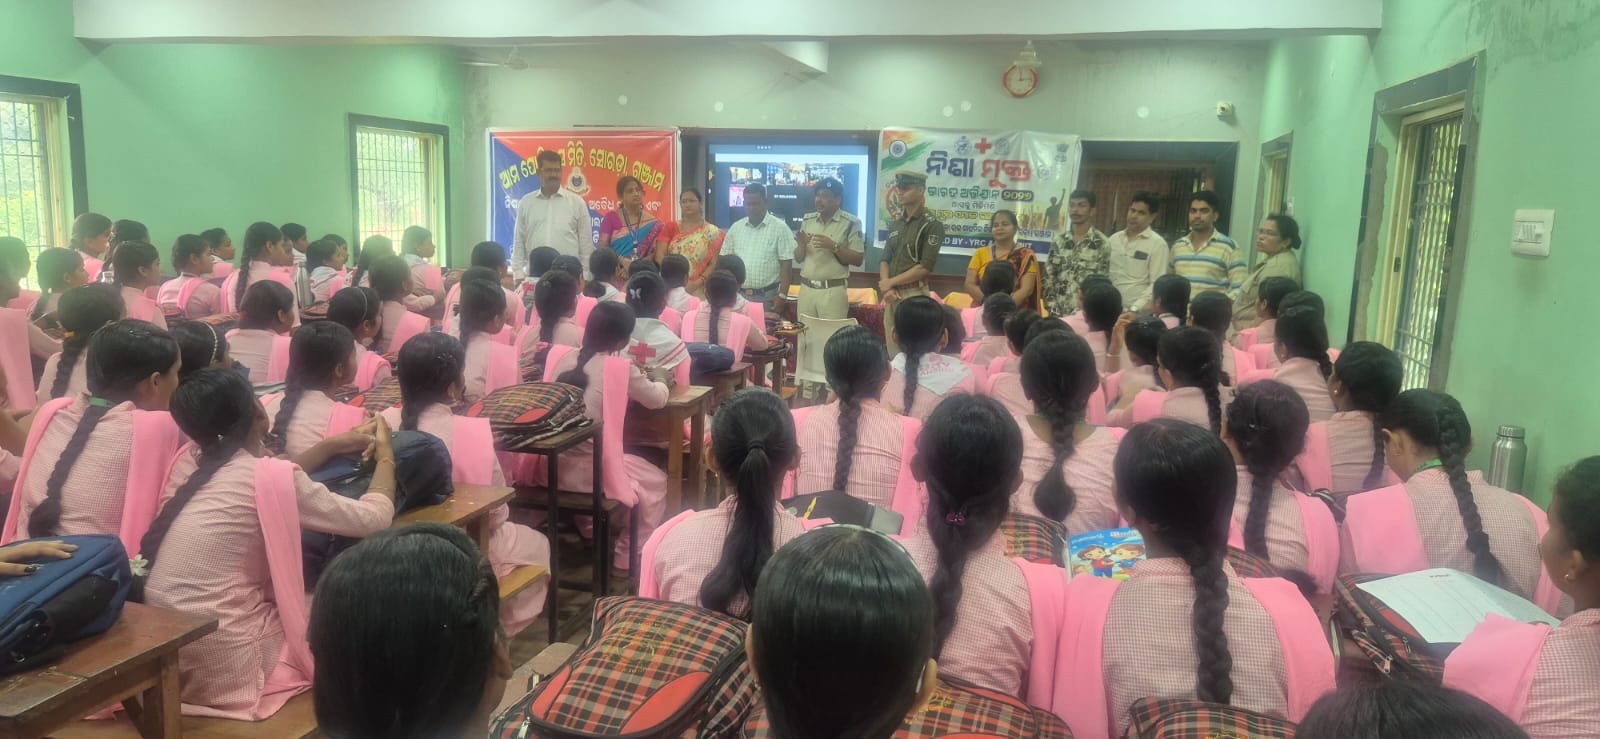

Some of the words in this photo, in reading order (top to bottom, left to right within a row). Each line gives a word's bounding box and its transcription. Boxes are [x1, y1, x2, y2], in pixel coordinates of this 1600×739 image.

[926, 150, 975, 178] ନିଶା
[981, 159, 1032, 189] ମୁକ୍ତ
[969, 238, 987, 247] YRC
